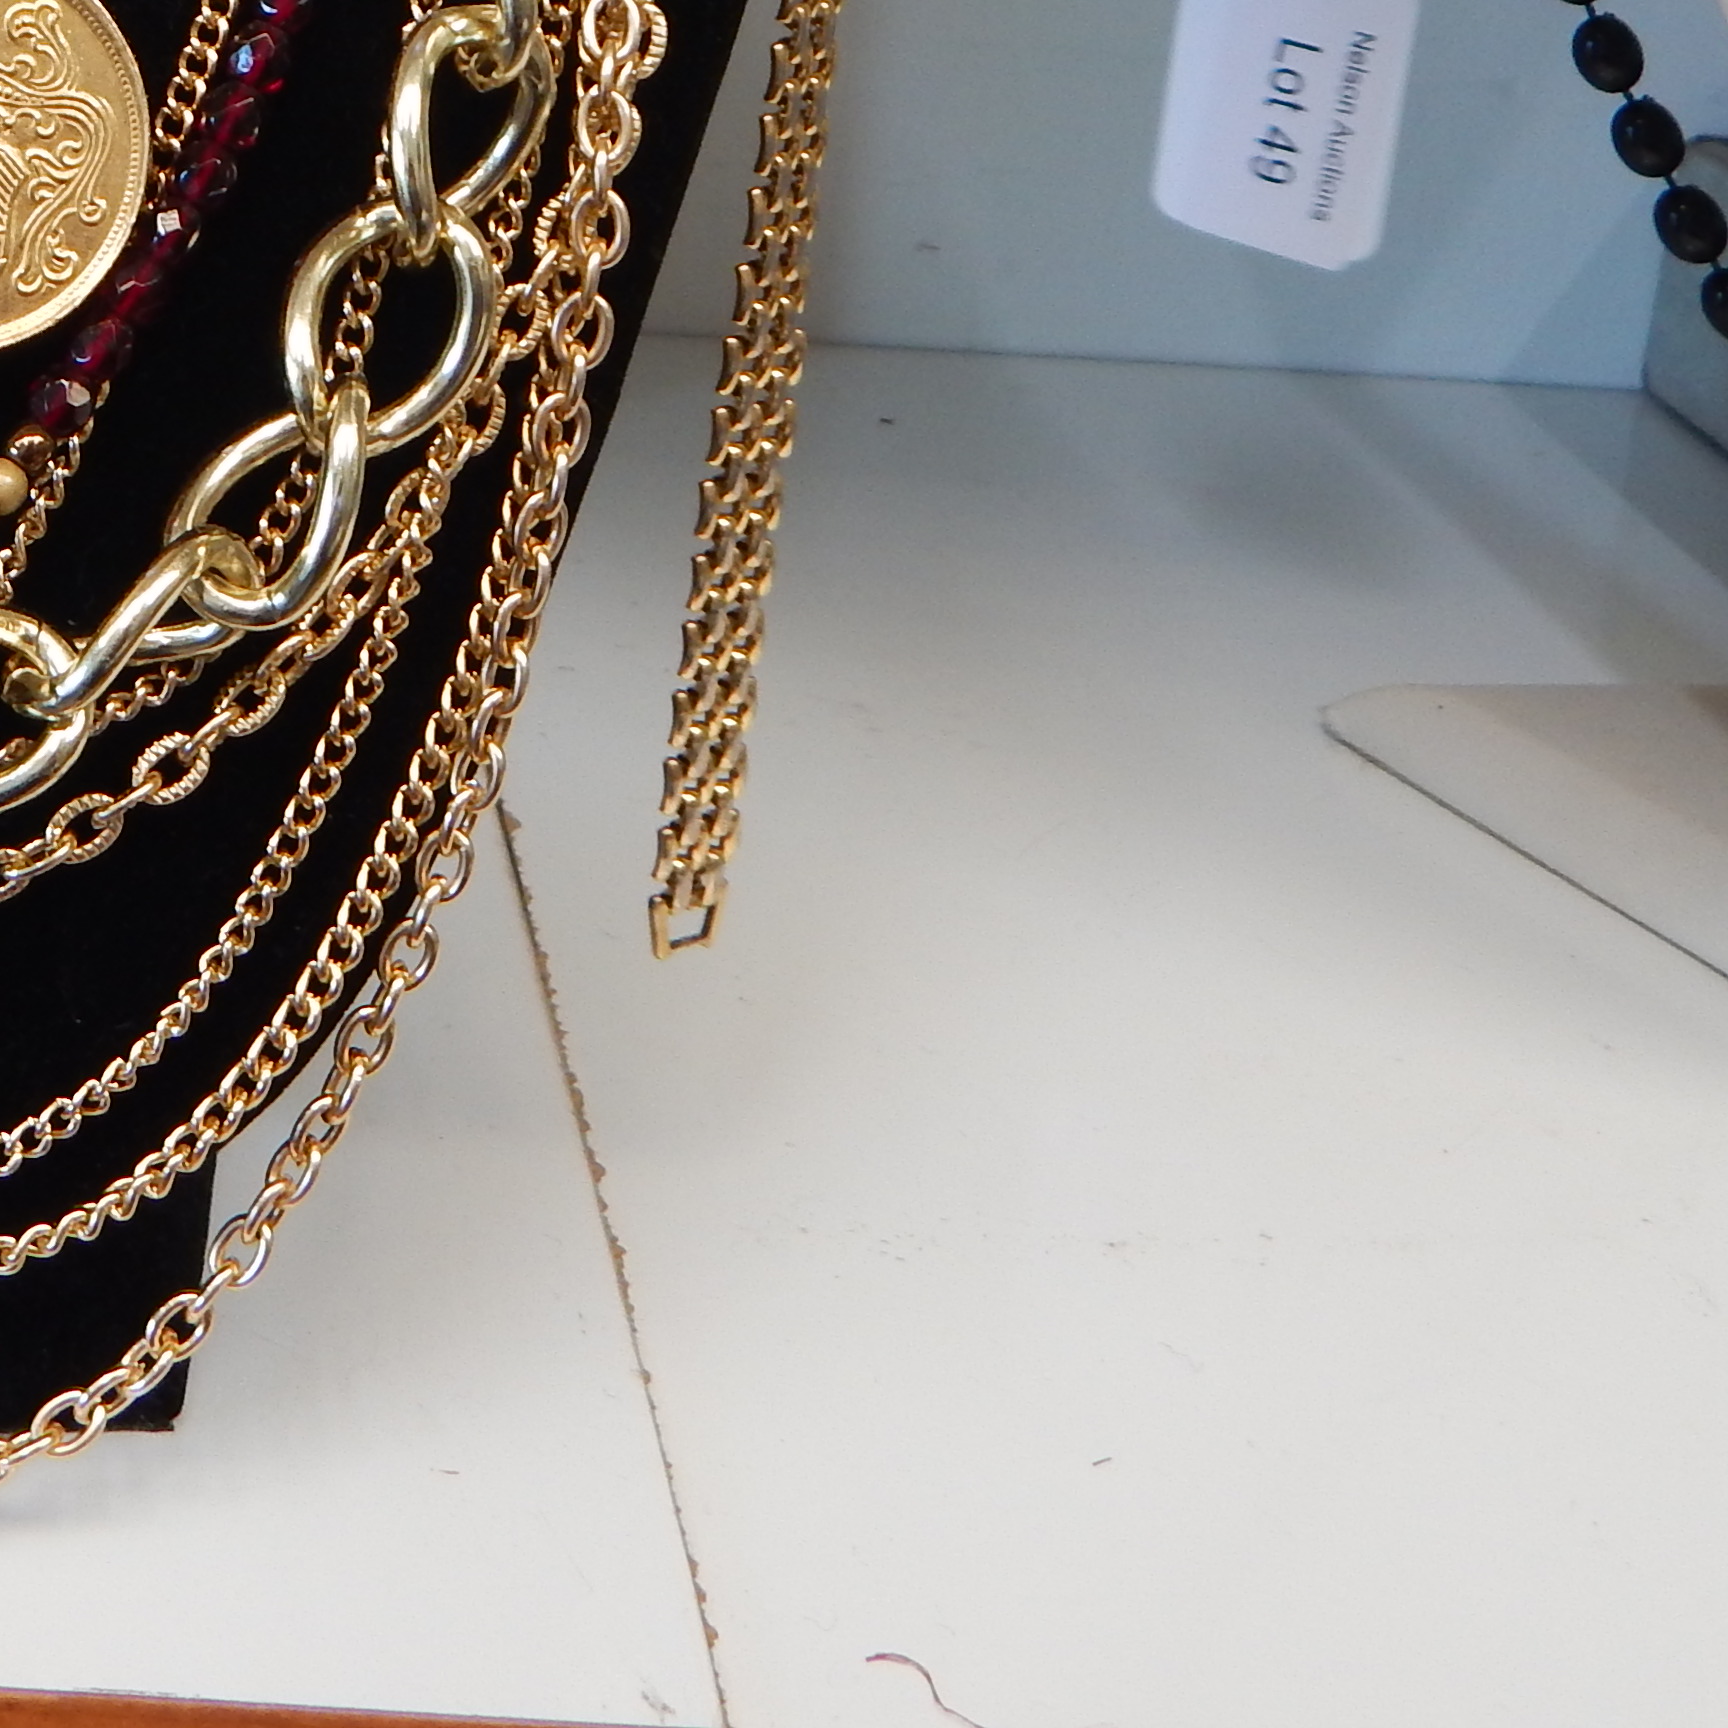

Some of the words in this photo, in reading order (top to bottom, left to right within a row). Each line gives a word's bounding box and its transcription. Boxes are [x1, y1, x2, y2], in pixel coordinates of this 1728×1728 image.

[1263, 37, 1323, 113] Lot
[1335, 31, 1378, 115] Nelson
[1247, 125, 1303, 185] 49
